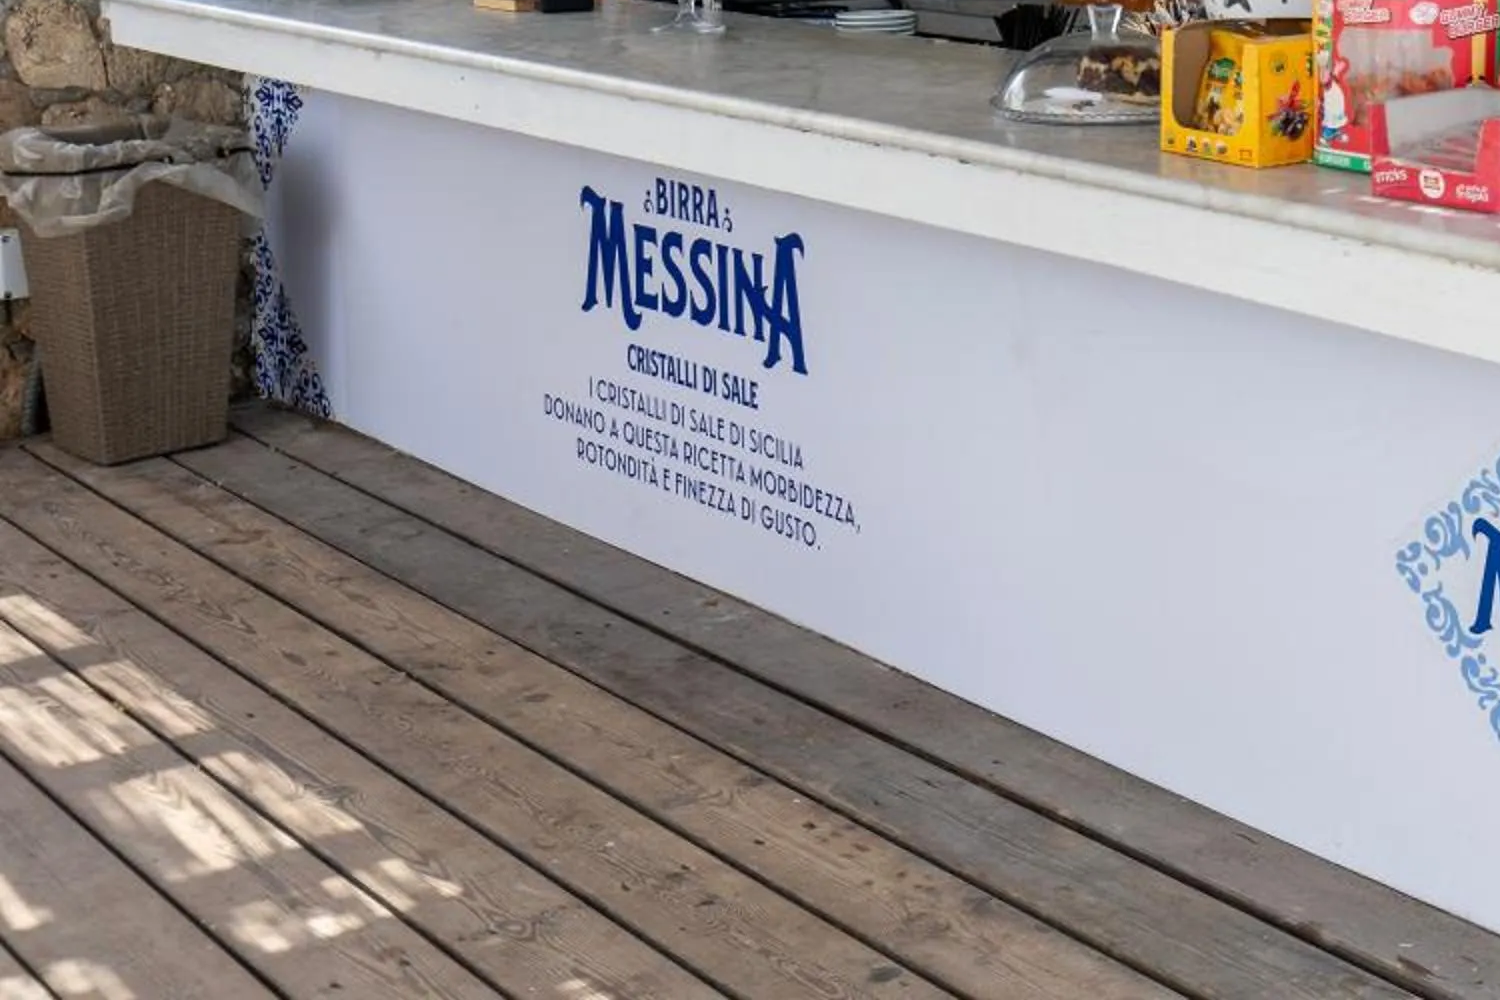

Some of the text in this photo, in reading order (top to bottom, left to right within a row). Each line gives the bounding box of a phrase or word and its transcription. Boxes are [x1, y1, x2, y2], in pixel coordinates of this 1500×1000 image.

[656, 177, 720, 229] BIRRA
[580, 185, 808, 375] MESSINA
[589, 376, 804, 471] I CRISTALLI DI SALE DI SICILIA
[627, 343, 759, 410] CRISTALLI DI SALE
[544, 393, 861, 534] DONANO A QUESTA RICETTA MORBIDEZZA,
[576, 437, 821, 551] ROTONDITÀ E FINEZZA DI GUSTO.
